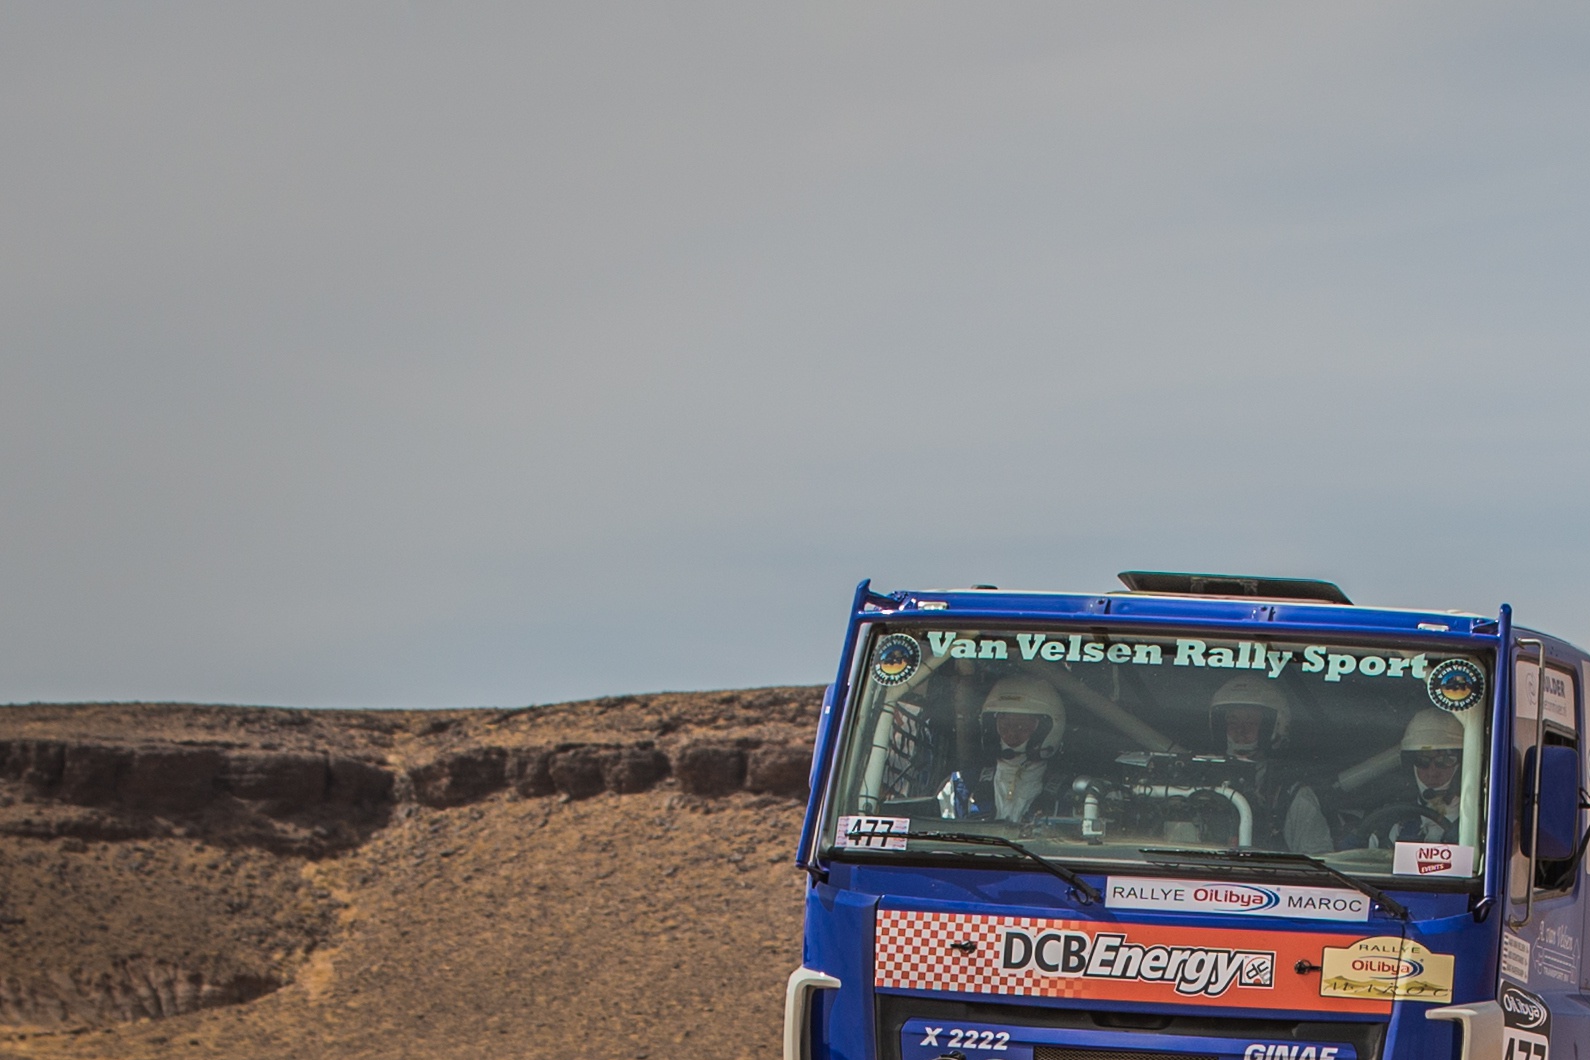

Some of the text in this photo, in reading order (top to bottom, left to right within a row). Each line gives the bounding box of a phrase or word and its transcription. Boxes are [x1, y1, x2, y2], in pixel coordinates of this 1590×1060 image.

[927, 631, 1428, 682] Van Velsen Rally Sport
[848, 819, 895, 847] 477
[1418, 847, 1453, 861] NPO
[1421, 863, 1445, 874] EVENTS
[1112, 886, 1362, 913] RALLYE OiLibya MAROC
[1359, 943, 1421, 954] RALLYE
[1351, 959, 1411, 976] OiLibya
[1503, 993, 1540, 1021] OiLibya
[920, 1026, 1011, 1051] X 2222
